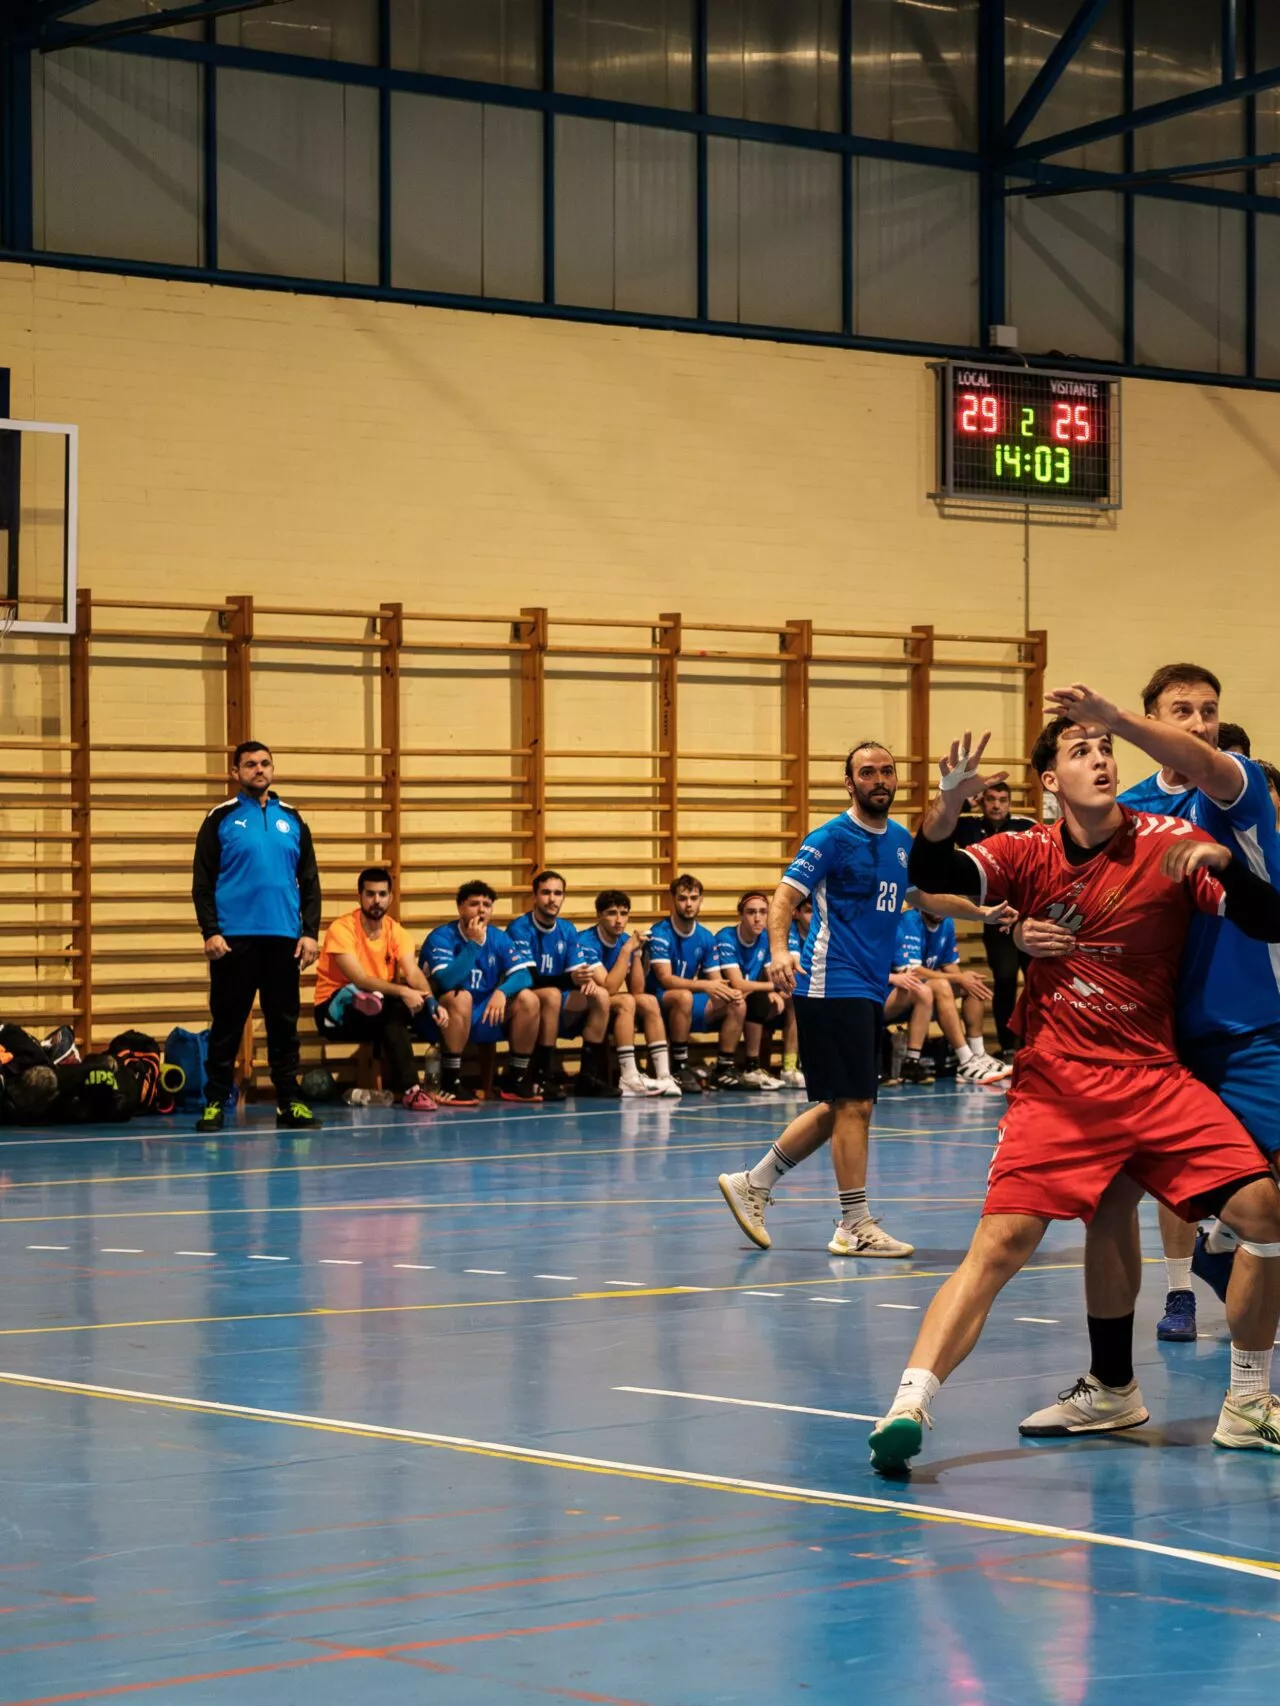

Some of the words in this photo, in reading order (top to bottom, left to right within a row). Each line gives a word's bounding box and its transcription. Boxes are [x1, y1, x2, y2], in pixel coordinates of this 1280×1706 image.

[958, 371, 991, 387] LOCAL
[1051, 380, 1098, 398] VISITANTE
[962, 394, 998, 433] 29
[1020, 407, 1034, 436] 2
[1055, 403, 1090, 441] 25
[994, 443, 1070, 484] 14:03
[876, 880, 898, 913] 23
[1045, 903, 1084, 933] 14
[540, 954, 554, 974] 14
[470, 968, 484, 990] 17
